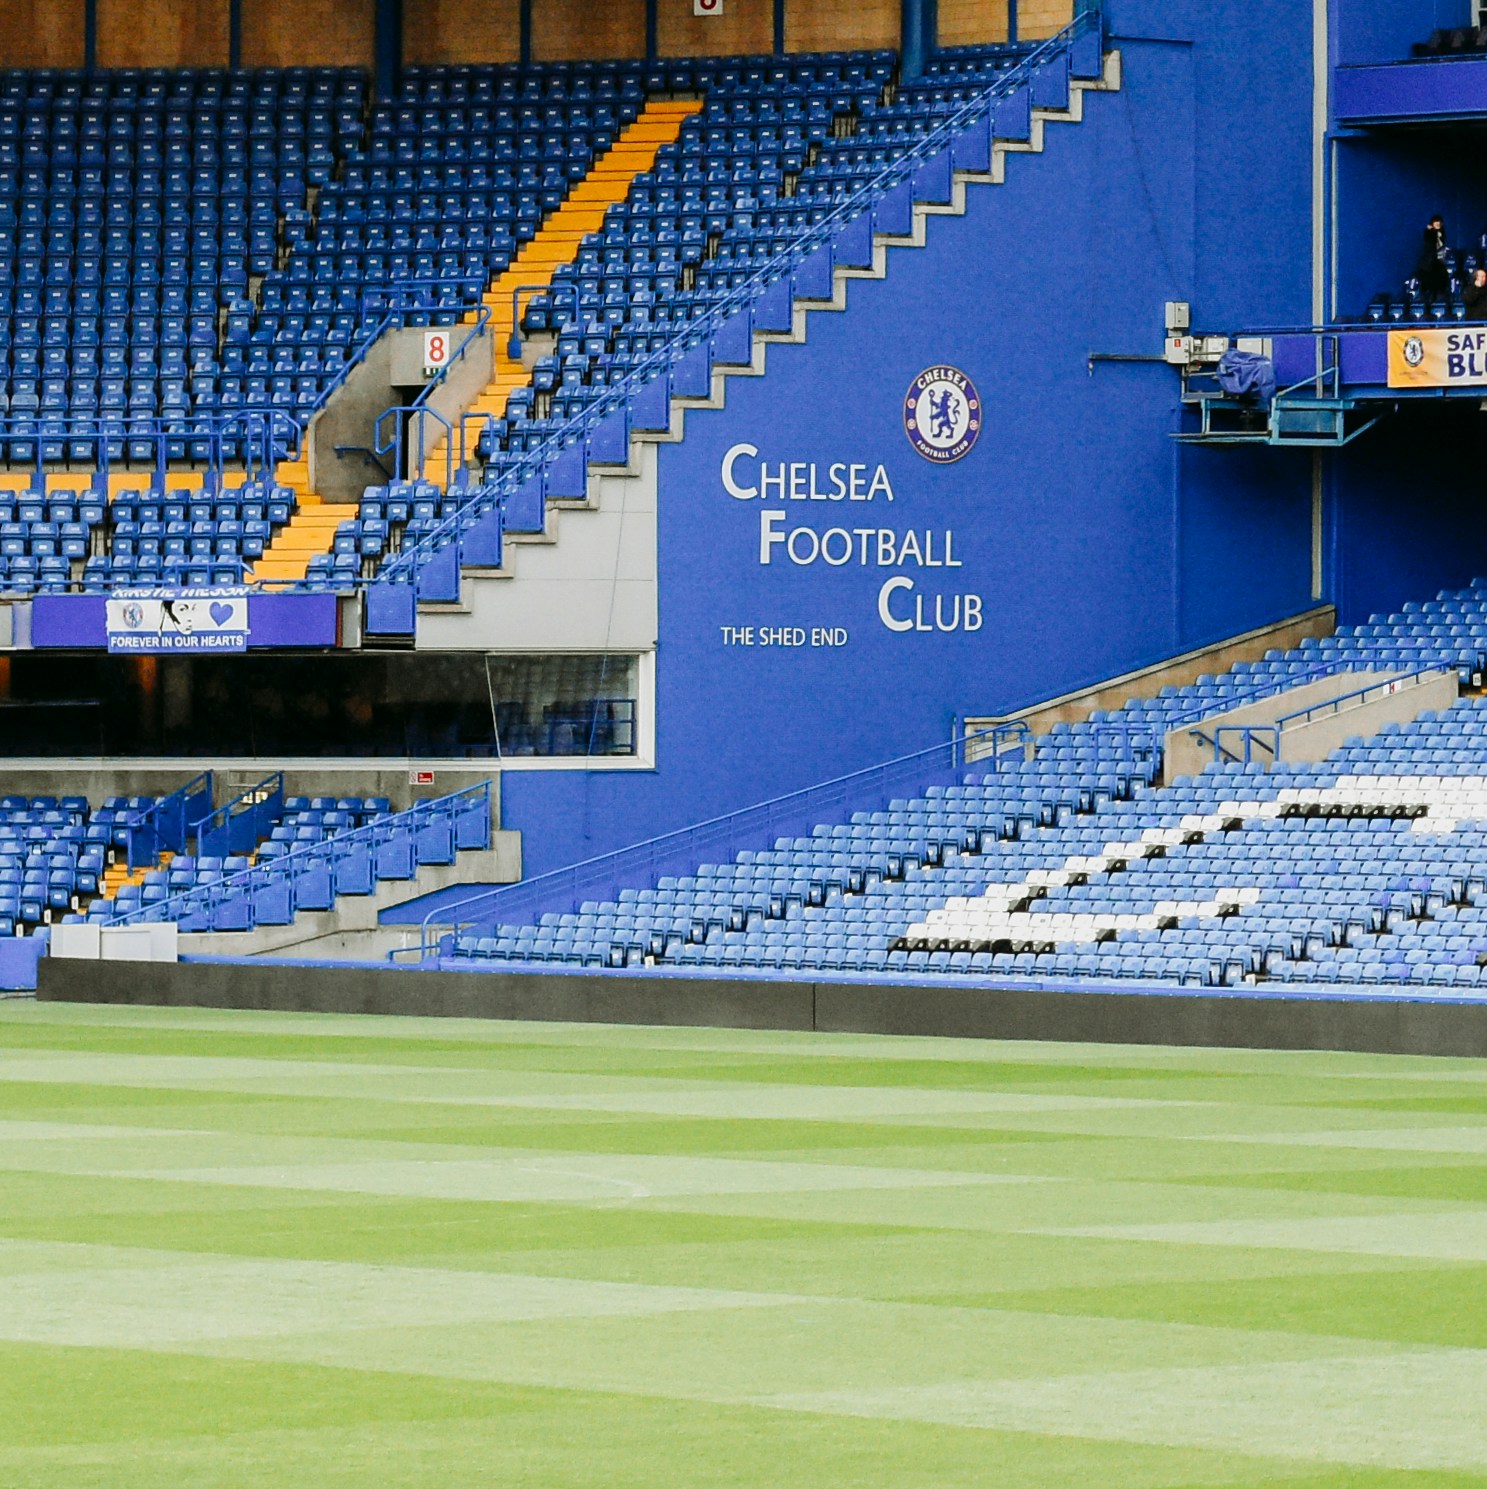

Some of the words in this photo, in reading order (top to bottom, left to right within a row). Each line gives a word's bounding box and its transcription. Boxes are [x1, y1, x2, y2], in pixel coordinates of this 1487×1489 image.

[429, 336, 444, 362] 8
[917, 369, 967, 390] CHELSEA
[917, 440, 949, 458] FOOTBALL
[952, 441, 968, 455] CLUB
[111, 636, 160, 647] FOREVER
[162, 636, 172, 646] IN
[175, 636, 198, 646] OUR
[201, 635, 243, 646] HEARTS
[720, 626, 754, 646] THE
[759, 627, 805, 646] SHED
[811, 628, 848, 646] END
